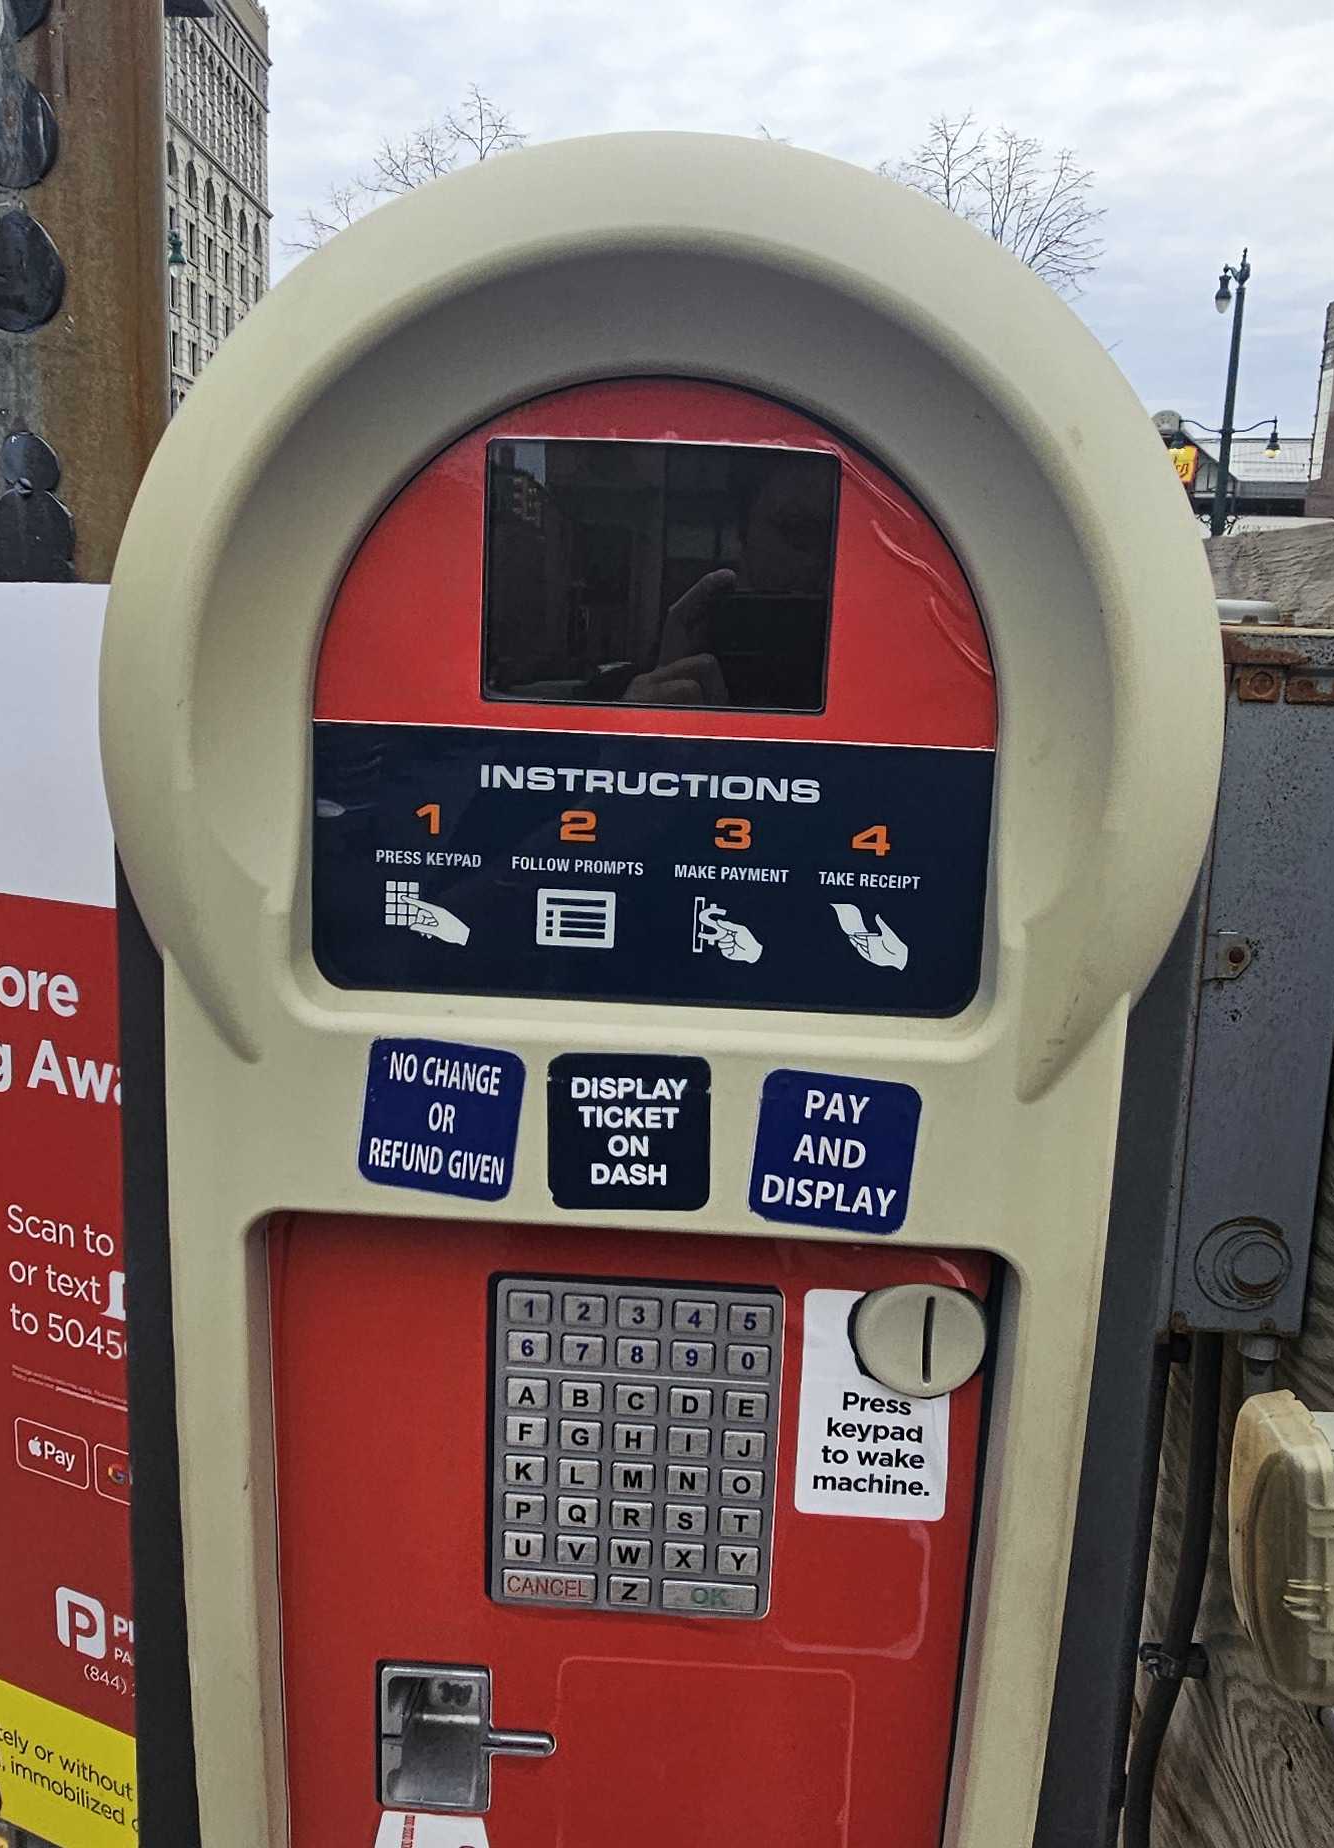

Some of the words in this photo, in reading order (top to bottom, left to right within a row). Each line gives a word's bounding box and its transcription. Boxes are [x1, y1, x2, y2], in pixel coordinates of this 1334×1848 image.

[479, 763, 822, 805] INSTRUCTIONS
[415, 804, 442, 836] 1
[559, 810, 598, 844] 2
[713, 817, 753, 852] 3
[850, 824, 892, 858] 4
[375, 849, 422, 868] PRESS
[425, 850, 483, 870] KEYPAD
[511, 855, 568, 875] FOLLOW
[573, 858, 645, 878] PROMPTS
[673, 864, 717, 882] MAKE
[720, 865, 790, 886] PAYMENT
[818, 871, 856, 888] TAKE
[858, 872, 922, 892] RECEIPT
[389, 1051, 418, 1083] NO
[422, 1056, 502, 1097] CHANGE
[570, 1077, 688, 1101] DISPLAY
[428, 1102, 456, 1134] OR
[578, 1105, 680, 1130] TICKET
[804, 1089, 871, 1125] PAY
[368, 1137, 444, 1176] REFUND
[448, 1150, 505, 1186] GIVEN
[607, 1135, 649, 1157] ON
[793, 1134, 867, 1170] AND
[590, 1163, 667, 1187] DASH
[761, 1174, 898, 1219] DISPLAY
[6, 1204, 74, 1249] Scan
[83, 1226, 115, 1257] to
[8, 1260, 38, 1286] or
[45, 1264, 101, 1305] text
[523, 1299, 535, 1319] 1
[577, 1303, 590, 1321] 2
[632, 1306, 645, 1325] 3
[687, 1310, 701, 1328] 4
[744, 1311, 757, 1331] 5
[10, 1303, 39, 1335] to
[47, 1312, 127, 1360] 5045
[520, 1339, 534, 1358] 6
[576, 1343, 589, 1362] 7
[630, 1345, 643, 1364] 8
[685, 1348, 698, 1366] 9
[741, 1351, 755, 1370] 0
[517, 1386, 536, 1404] A
[573, 1389, 589, 1408] B
[627, 1392, 644, 1411] C
[682, 1395, 699, 1413] D
[739, 1399, 754, 1417] E
[842, 1390, 912, 1417] Press
[518, 1423, 532, 1441] F
[571, 1427, 590, 1446] G
[625, 1431, 641, 1449] H
[685, 1435, 691, 1452] I
[737, 1439, 751, 1457] J
[827, 1418, 923, 1445] keypad
[44, 1441, 76, 1471] Pay
[822, 1445, 848, 1466] to
[857, 1447, 925, 1470] wake
[515, 1463, 533, 1481] K
[570, 1466, 584, 1484] L
[623, 1470, 643, 1488] M
[679, 1473, 695, 1491] N
[732, 1475, 751, 1494] O
[812, 1472, 930, 1497] machine.
[516, 1501, 530, 1519] P
[568, 1504, 587, 1524] Q
[624, 1508, 640, 1526] R
[677, 1512, 693, 1530] S
[734, 1515, 750, 1532] T
[515, 1539, 530, 1557] U
[568, 1543, 584, 1560] V
[617, 1546, 641, 1564] W
[675, 1550, 692, 1568] X
[731, 1552, 748, 1571] Y
[507, 1575, 589, 1598] CANCEL
[621, 1583, 638, 1601] Z
[690, 1587, 727, 1607] OK
[84, 1663, 127, 1695] (844)
[35, 1743, 54, 1764] or
[59, 1755, 133, 1802] without
[11, 1760, 124, 1826] immobilized
